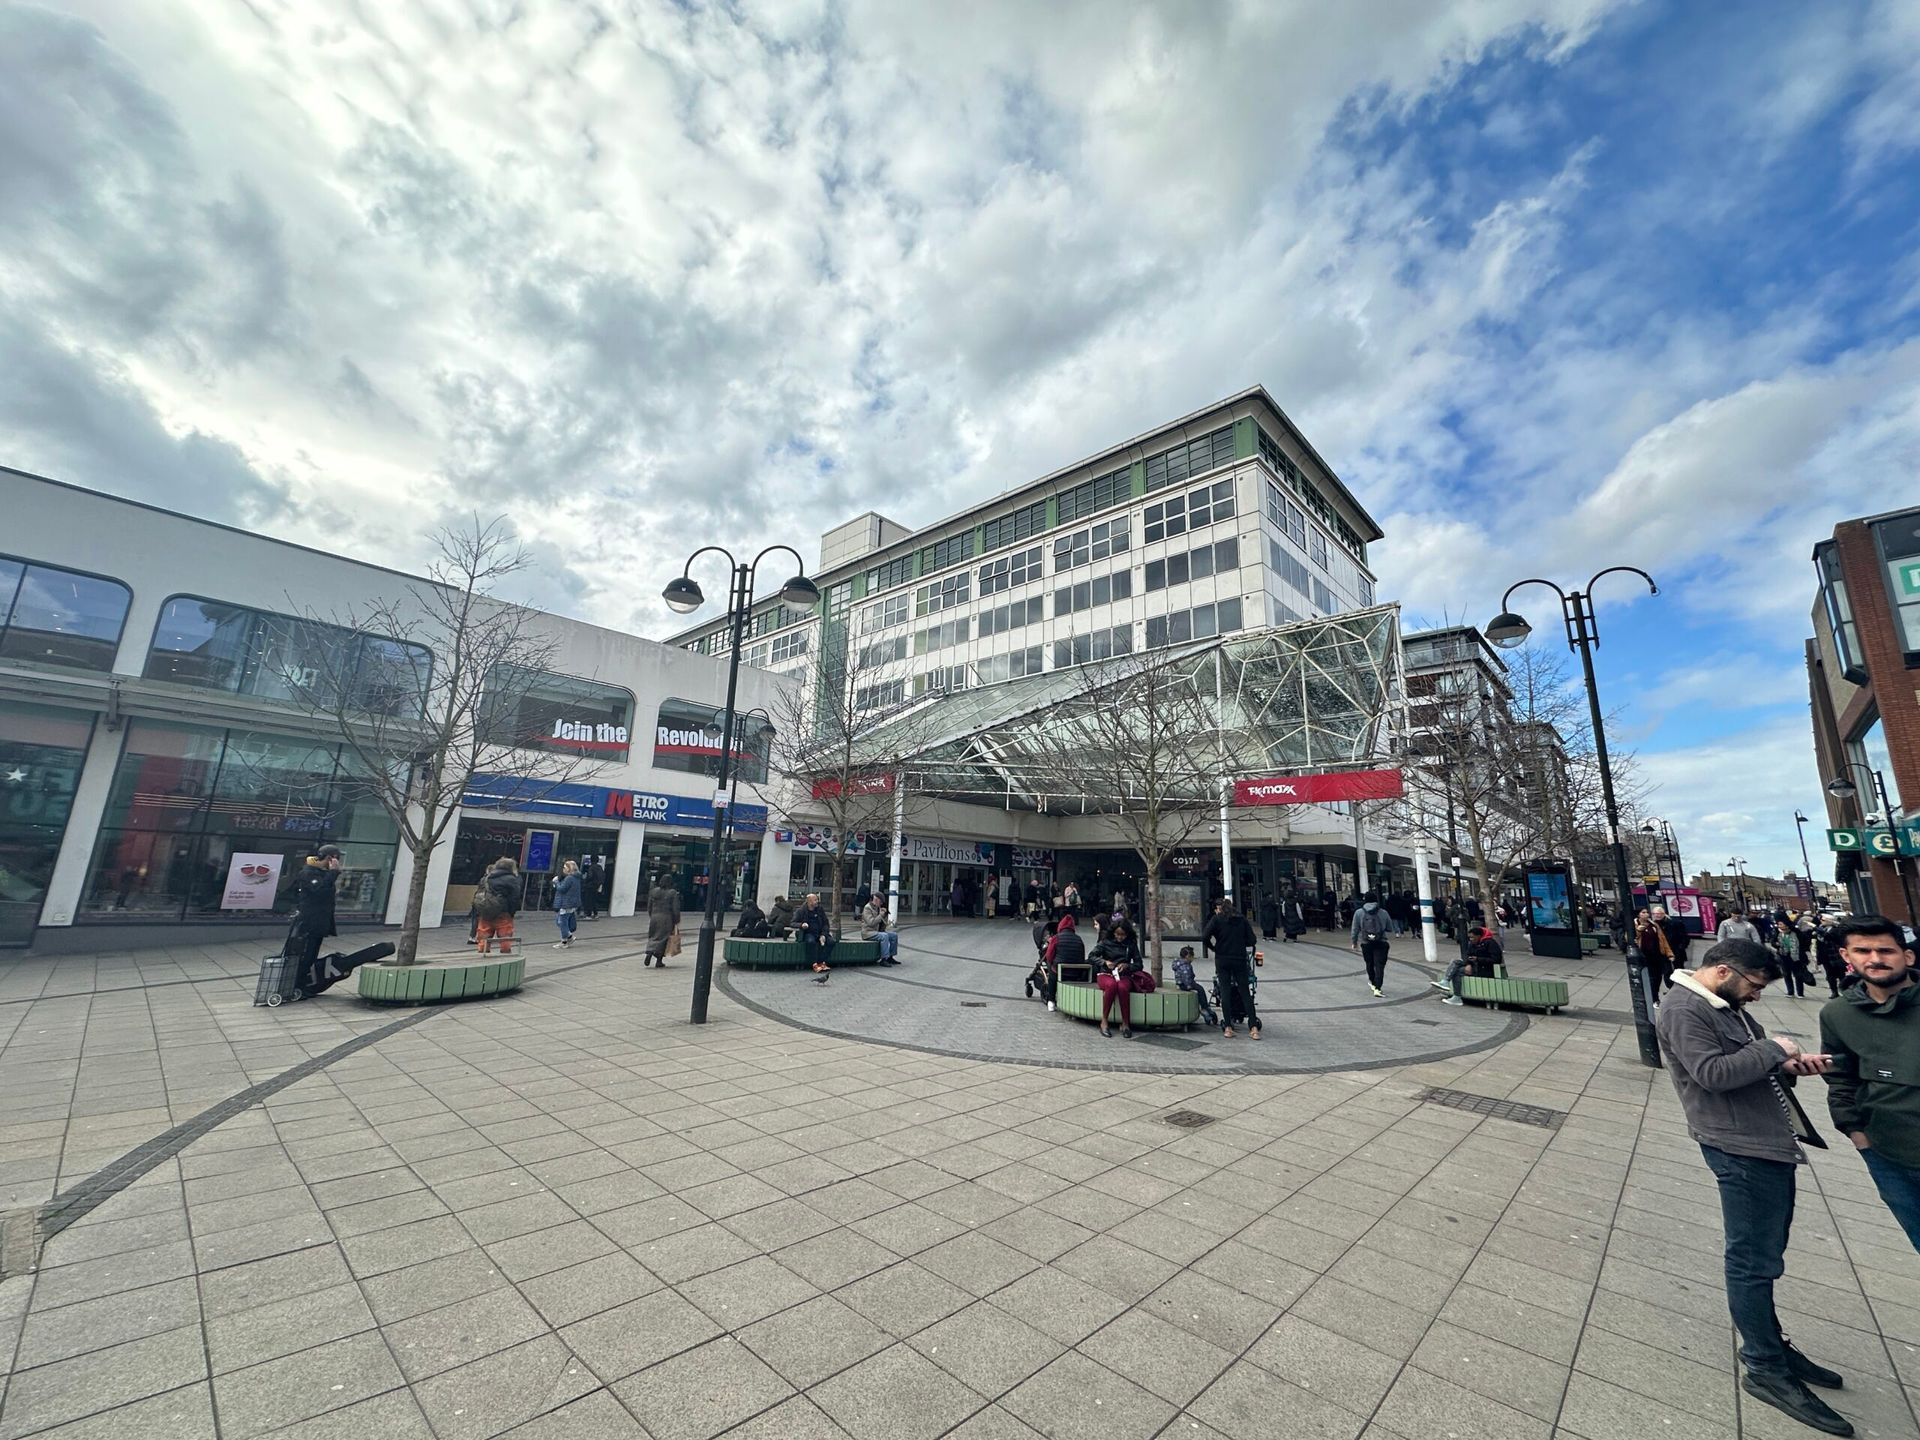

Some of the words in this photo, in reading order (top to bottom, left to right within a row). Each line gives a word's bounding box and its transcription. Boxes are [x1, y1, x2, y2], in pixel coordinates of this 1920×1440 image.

[551, 718, 593, 742] Join
[596, 723, 628, 744] the
[657, 726, 744, 752] Revolutin
[605, 789, 669, 818] METRO
[633, 809, 667, 821] BANK
[912, 838, 970, 861] Pavilions
[1172, 857, 1200, 865] COSTA
